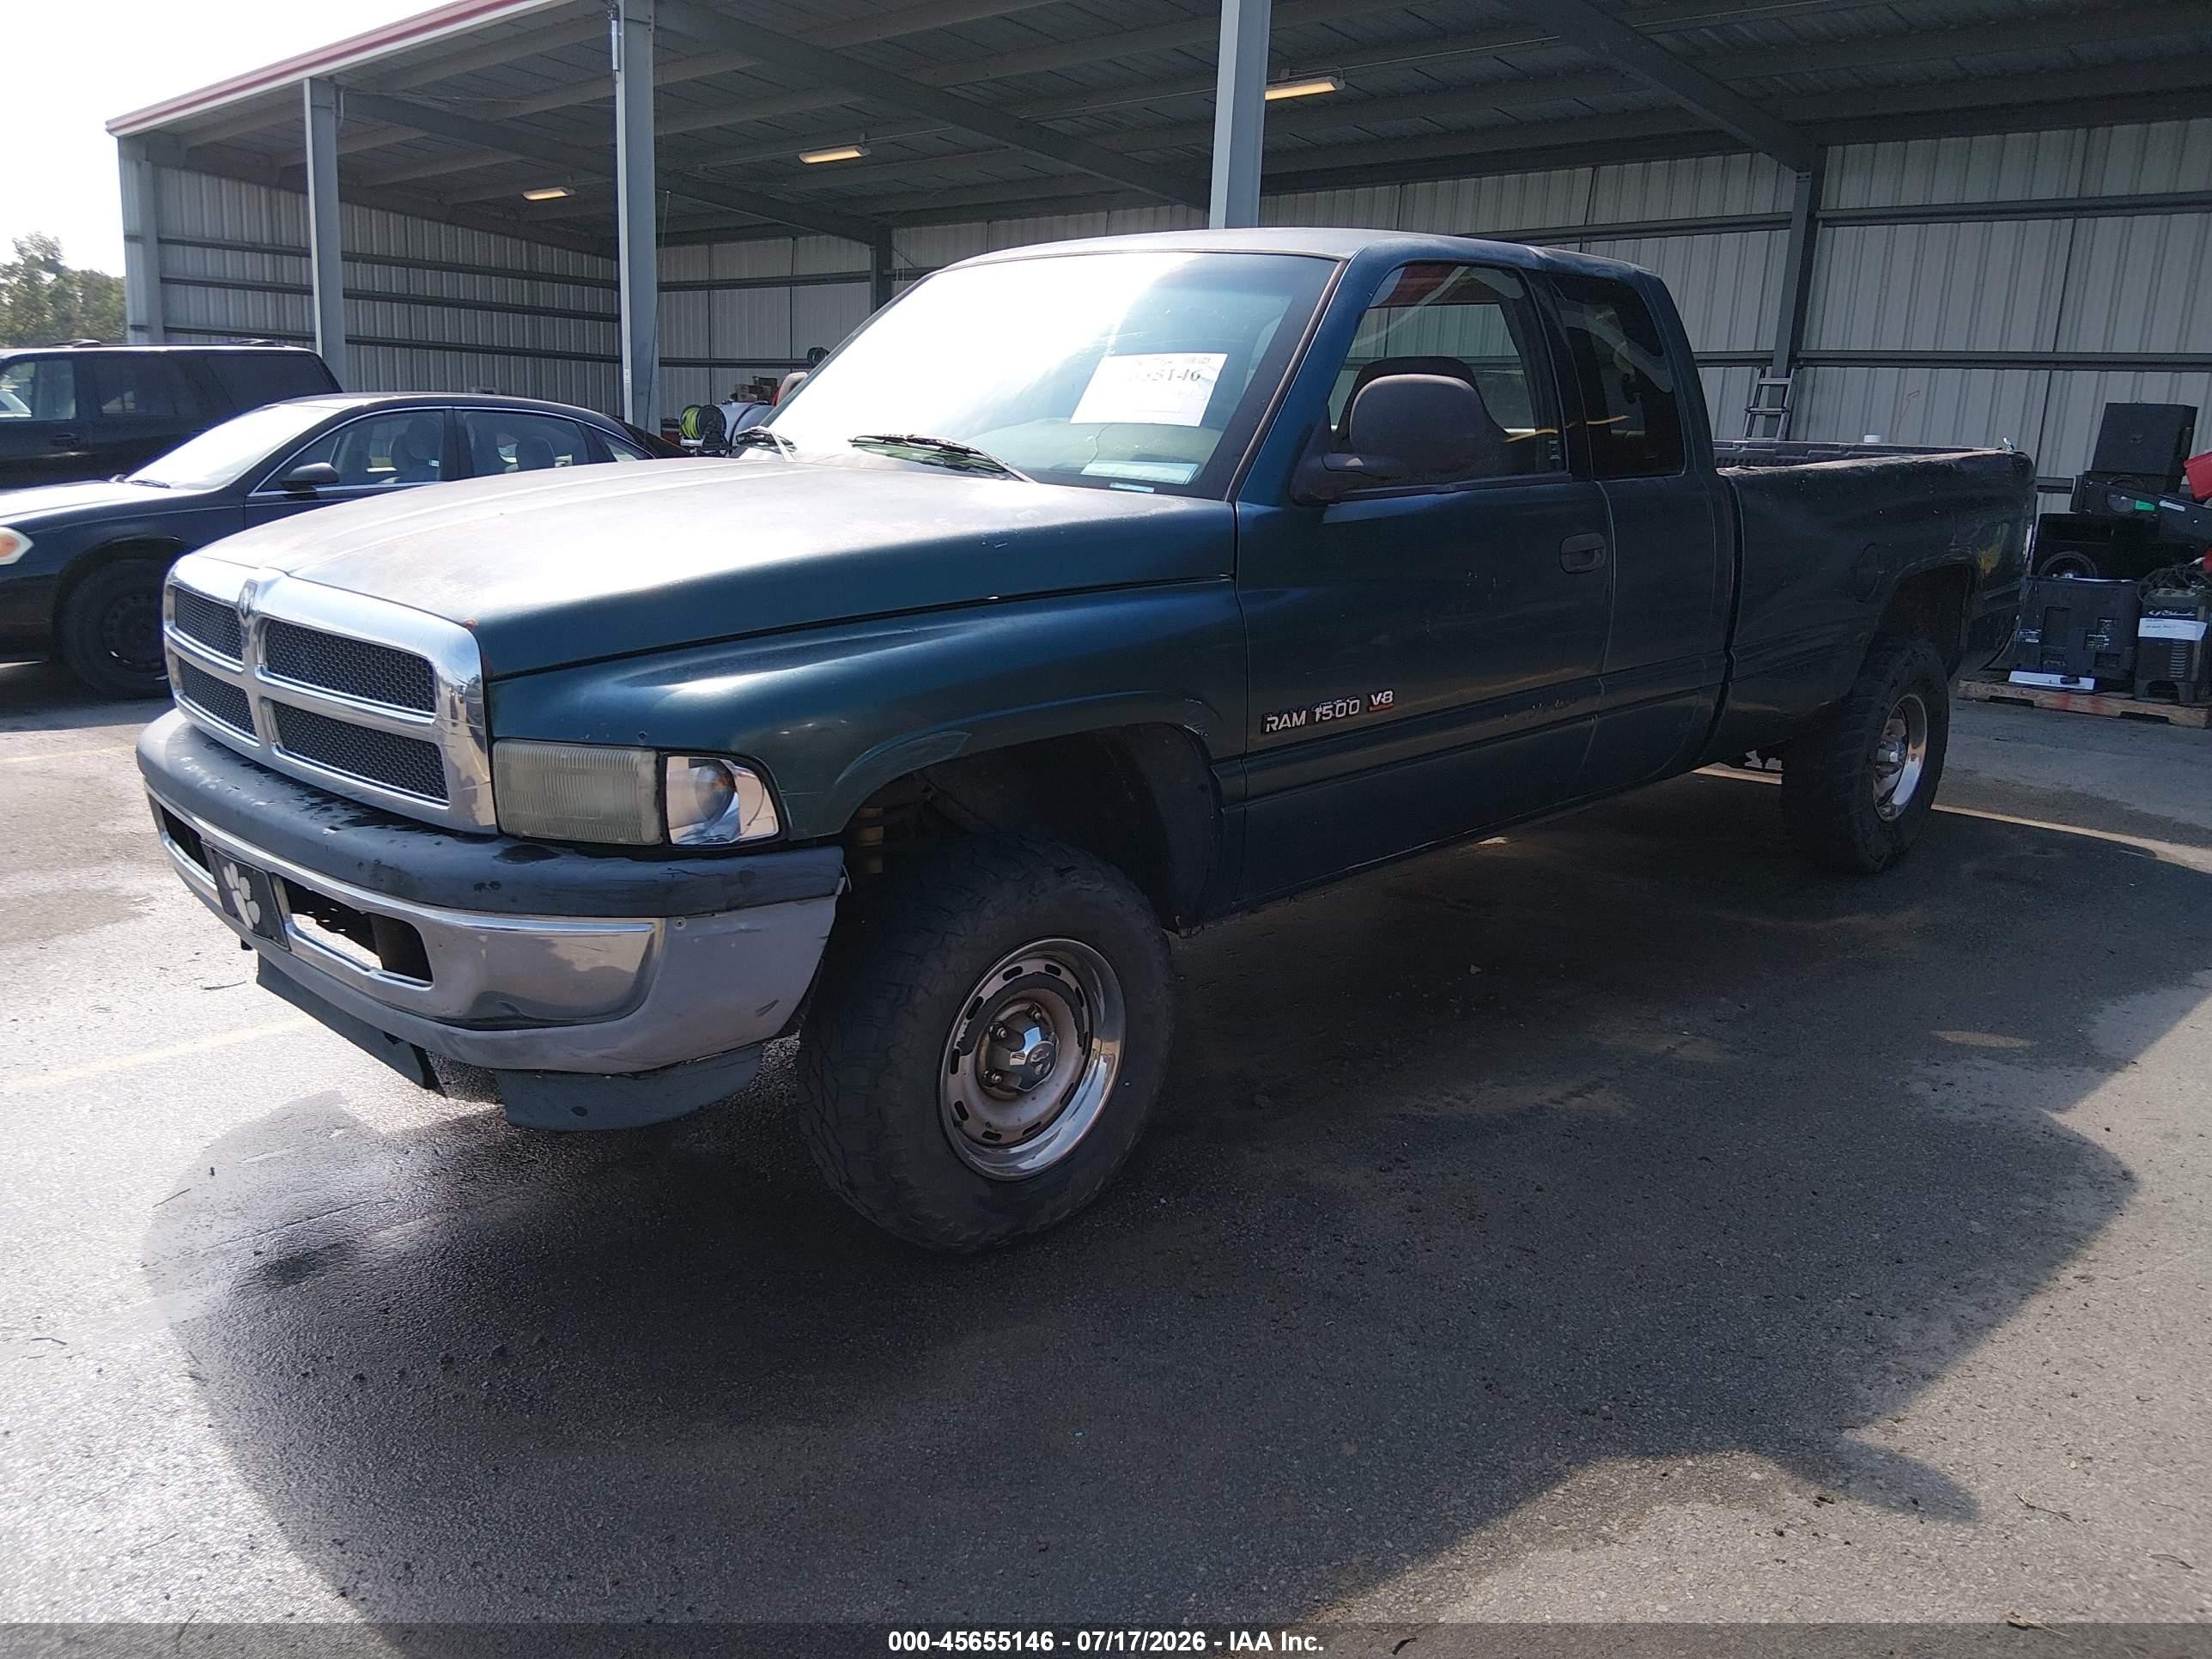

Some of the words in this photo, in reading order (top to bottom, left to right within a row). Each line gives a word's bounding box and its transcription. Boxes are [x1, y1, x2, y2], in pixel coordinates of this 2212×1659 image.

[1265, 709, 1307, 733] RAM
[1314, 697, 1361, 723] 1500
[1370, 690, 1395, 706] V8
